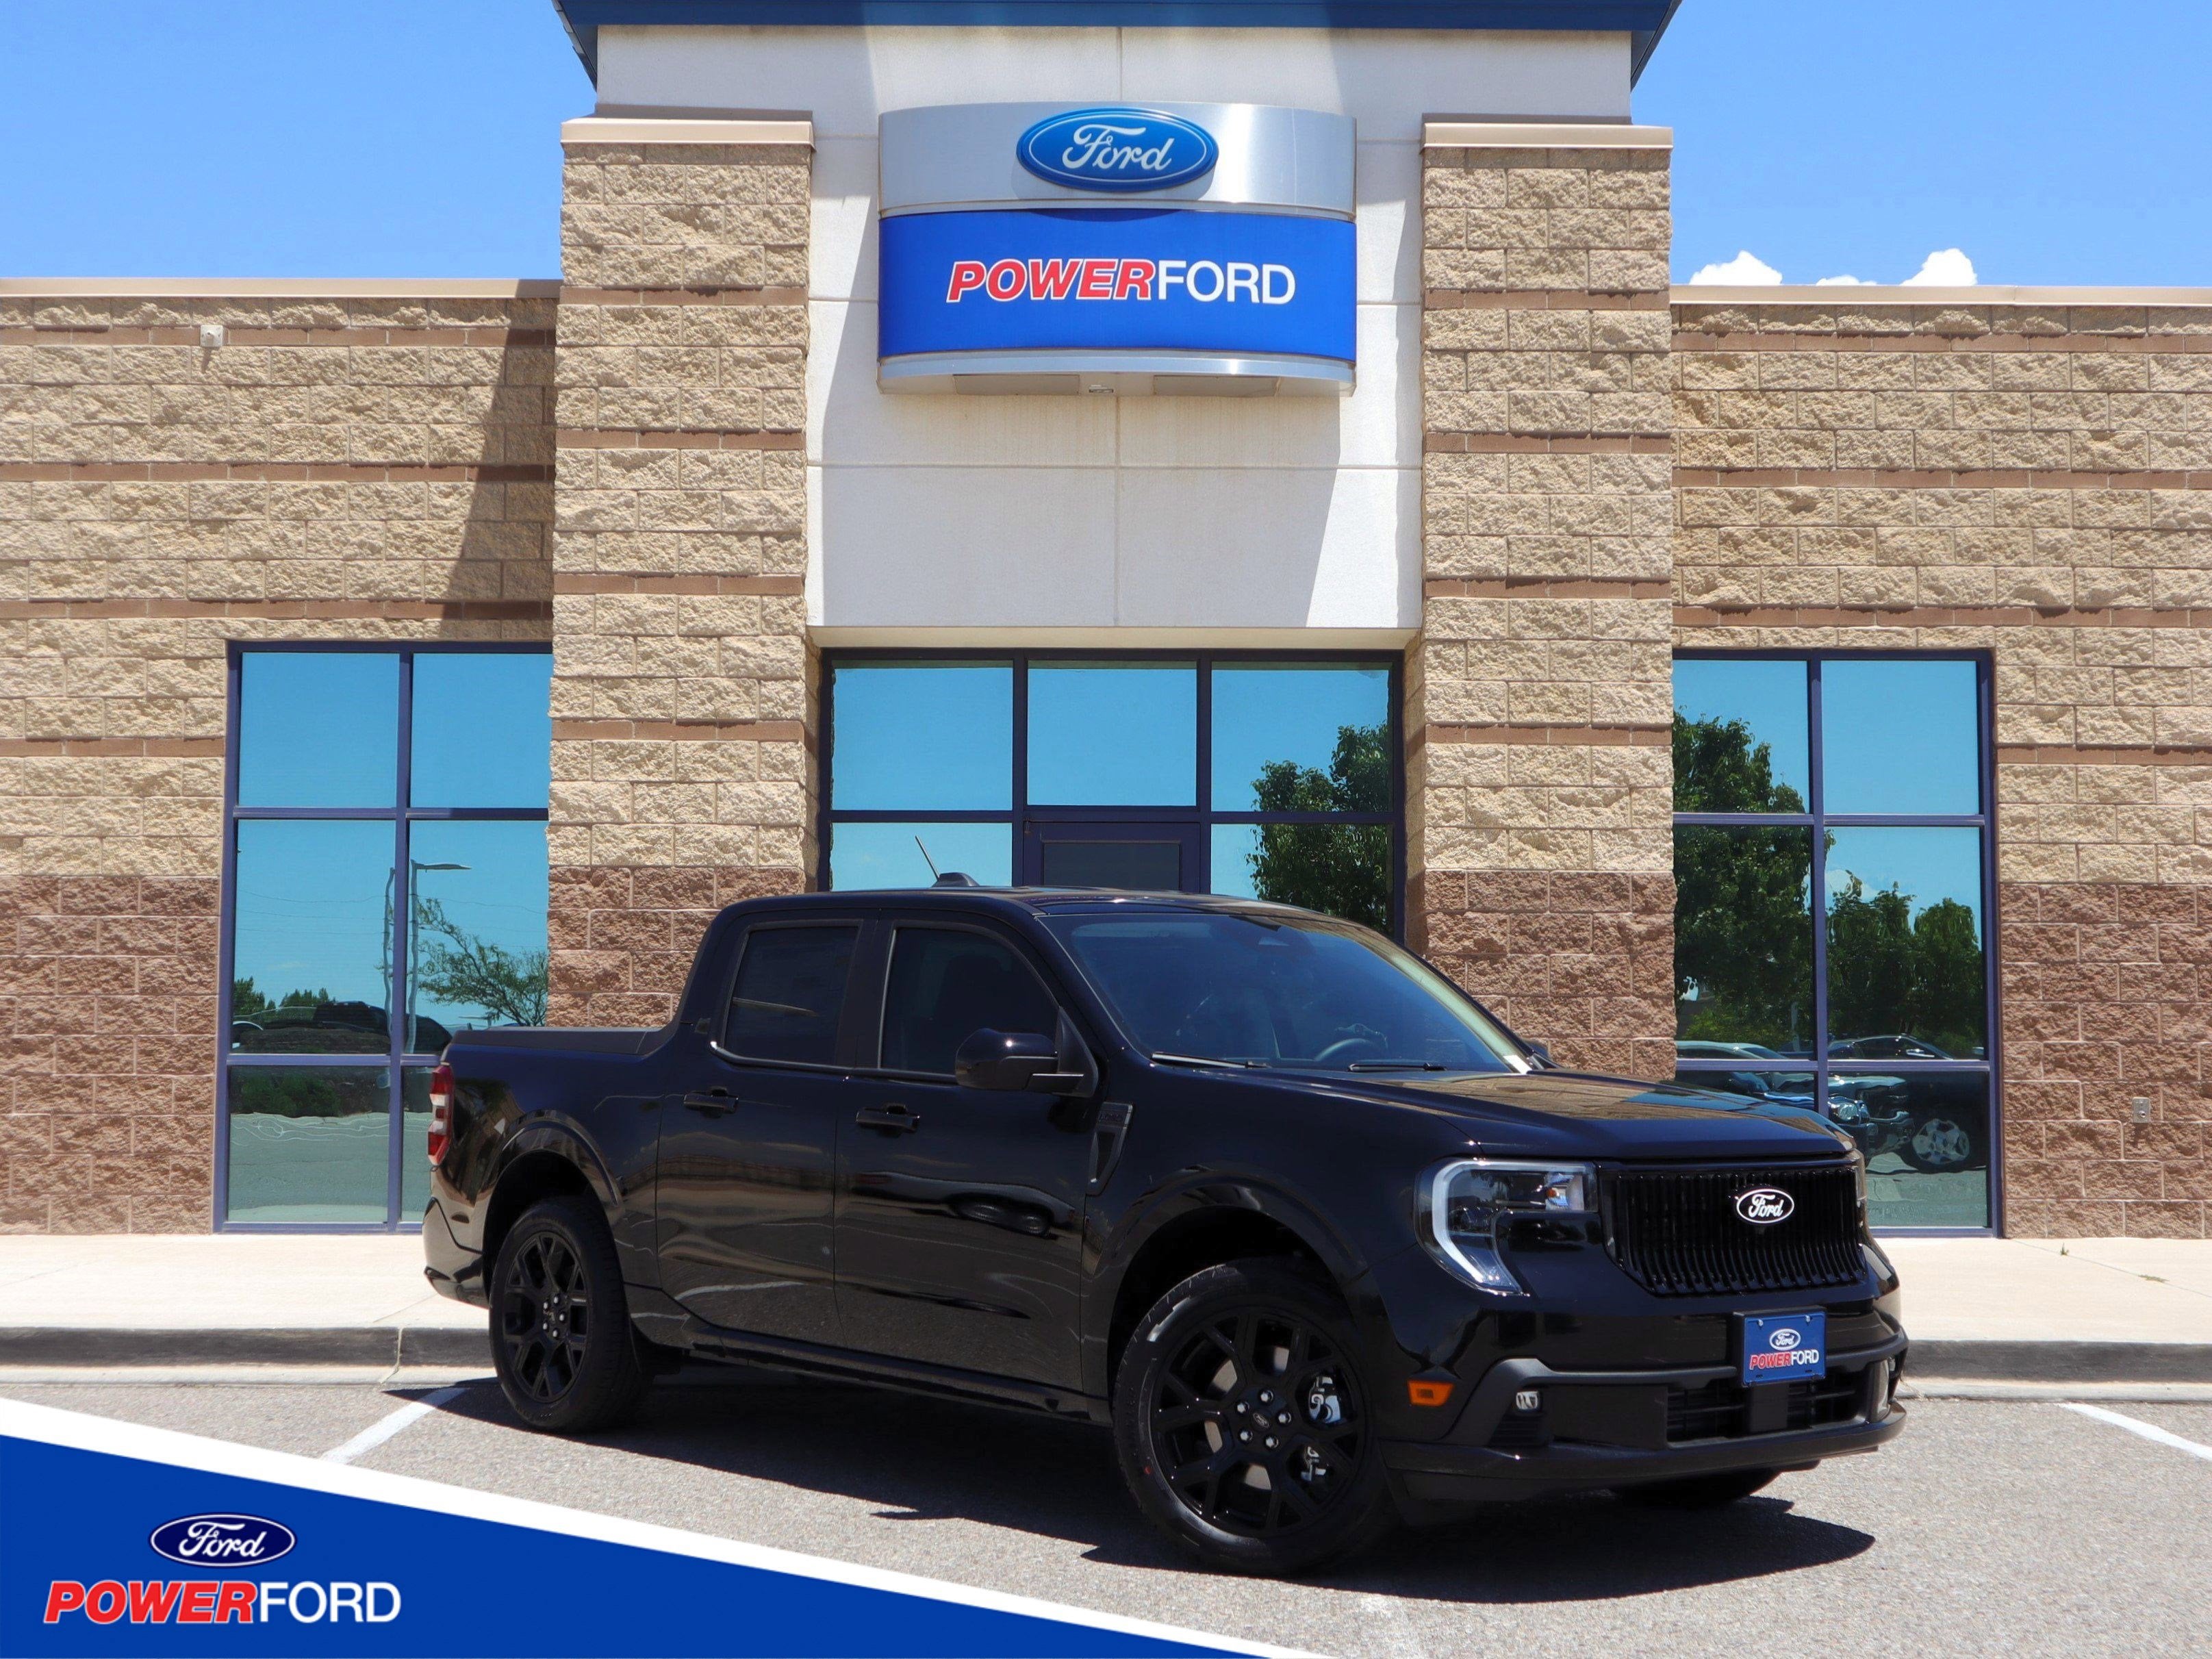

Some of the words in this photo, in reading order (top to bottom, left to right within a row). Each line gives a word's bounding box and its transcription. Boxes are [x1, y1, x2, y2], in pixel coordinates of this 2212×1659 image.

[1062, 123, 1173, 171] Ford
[1748, 1193, 1784, 1217] Ford
[1775, 1332, 1795, 1345] Ford
